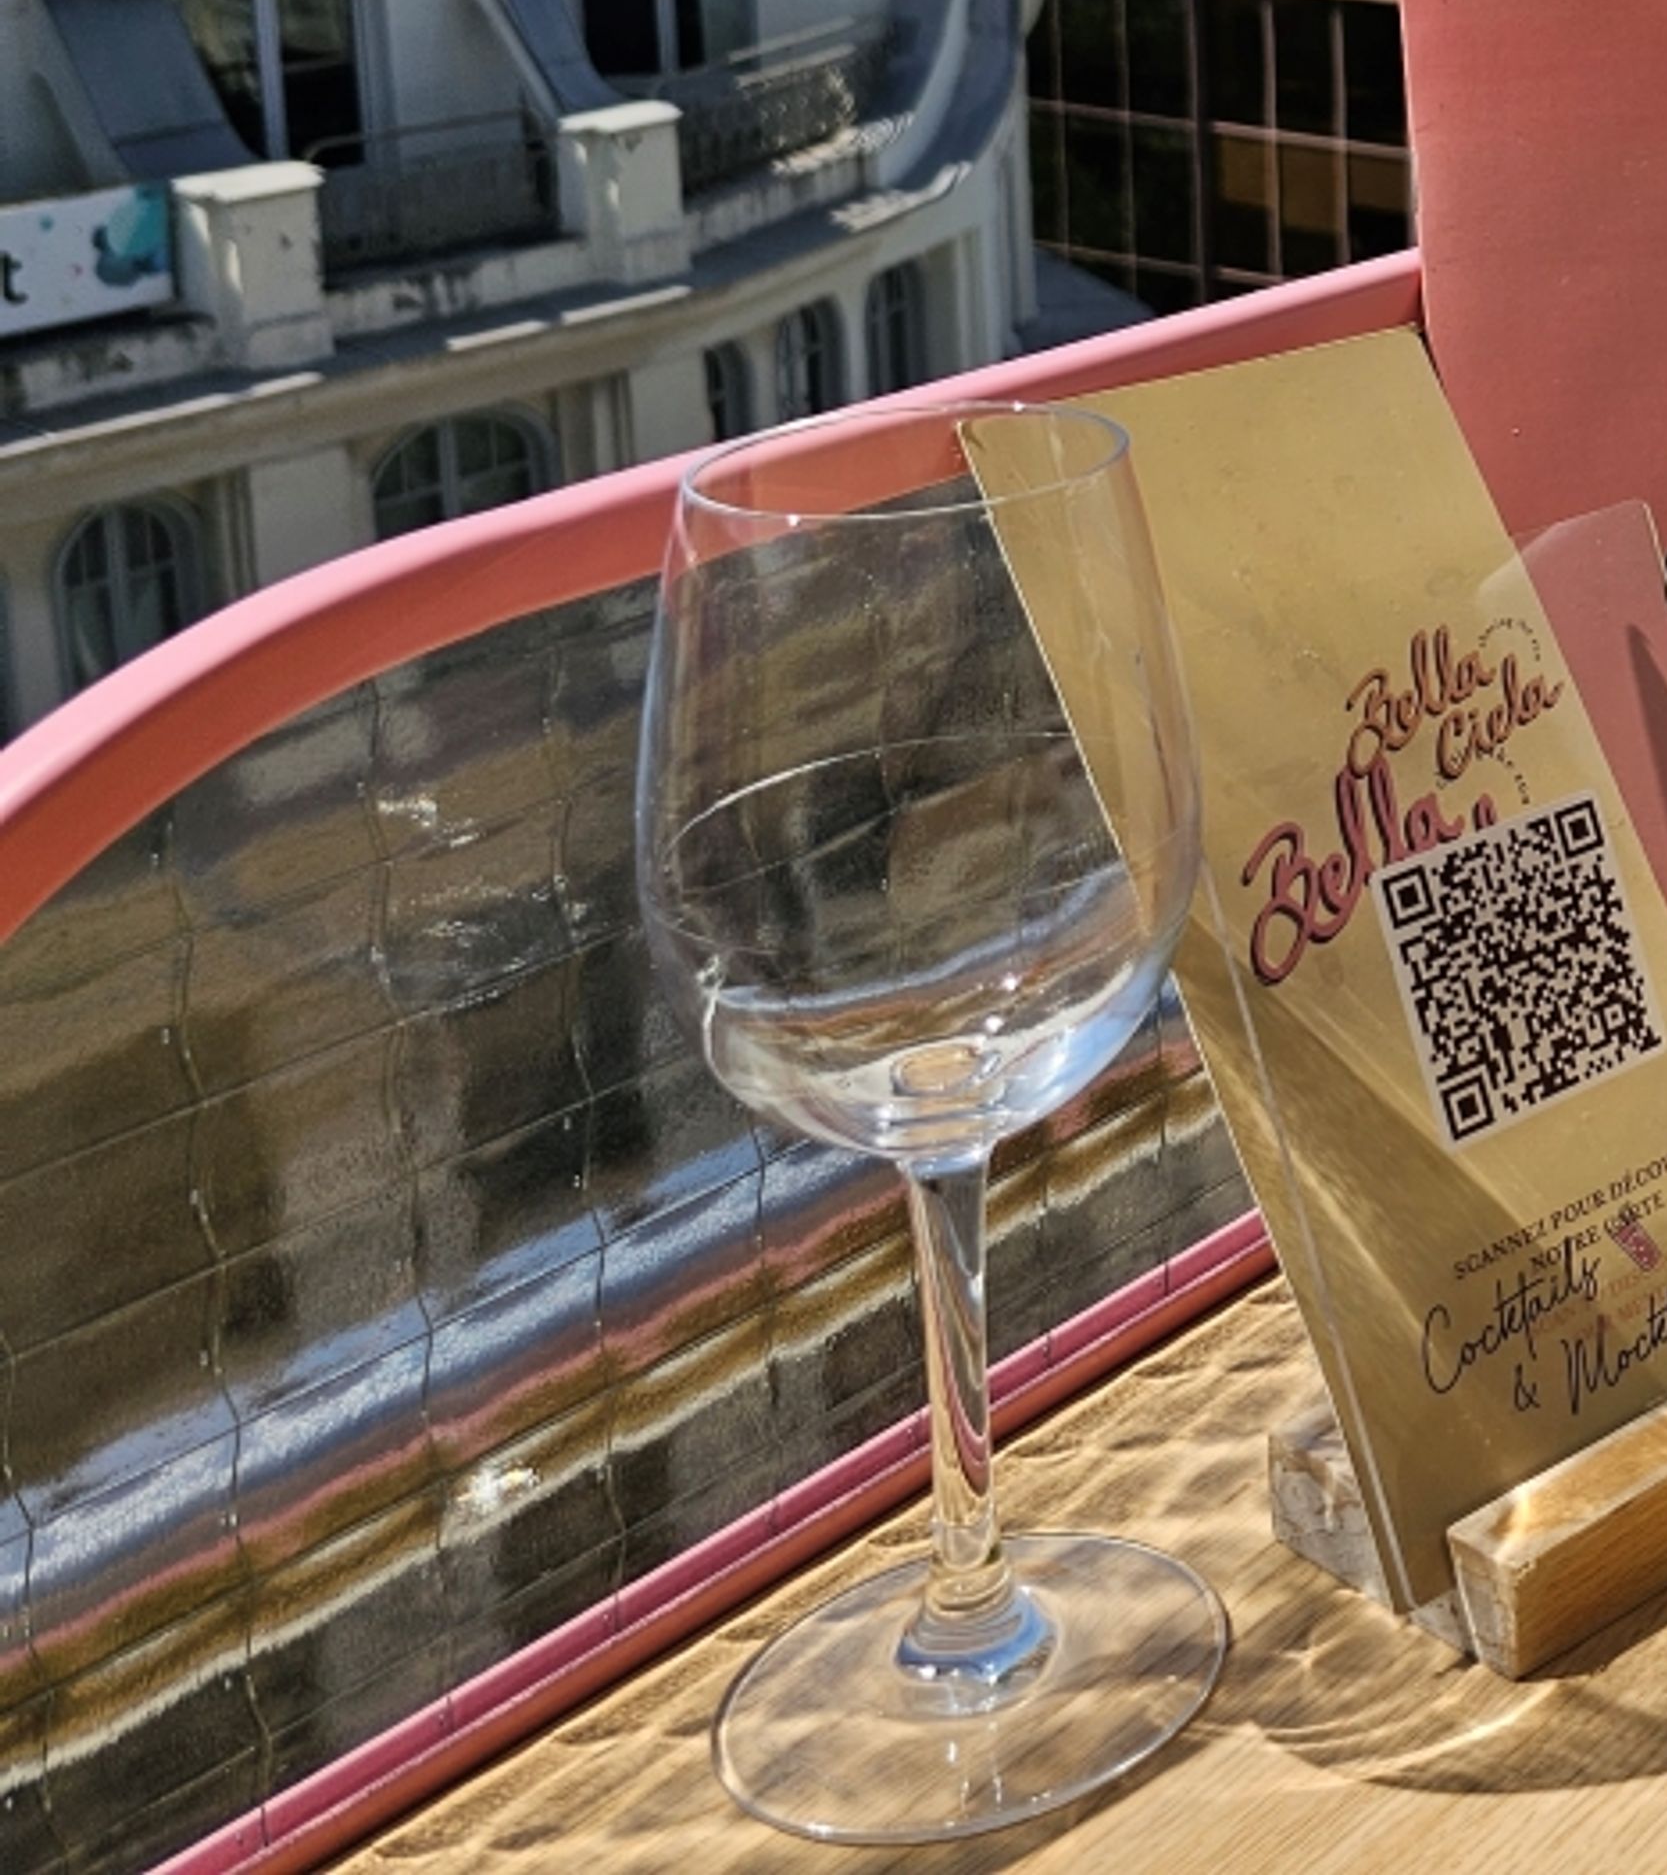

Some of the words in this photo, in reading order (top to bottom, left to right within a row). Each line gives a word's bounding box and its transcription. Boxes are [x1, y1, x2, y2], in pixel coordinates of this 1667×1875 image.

[1345, 624, 1498, 778] Bella
[1435, 653, 1565, 780] Ciela
[1241, 755, 1466, 987] Bella
[1453, 1216, 1549, 1280] SCANNEZ
[1550, 1188, 1607, 1231] POUR
[1513, 1363, 1541, 1413] &
